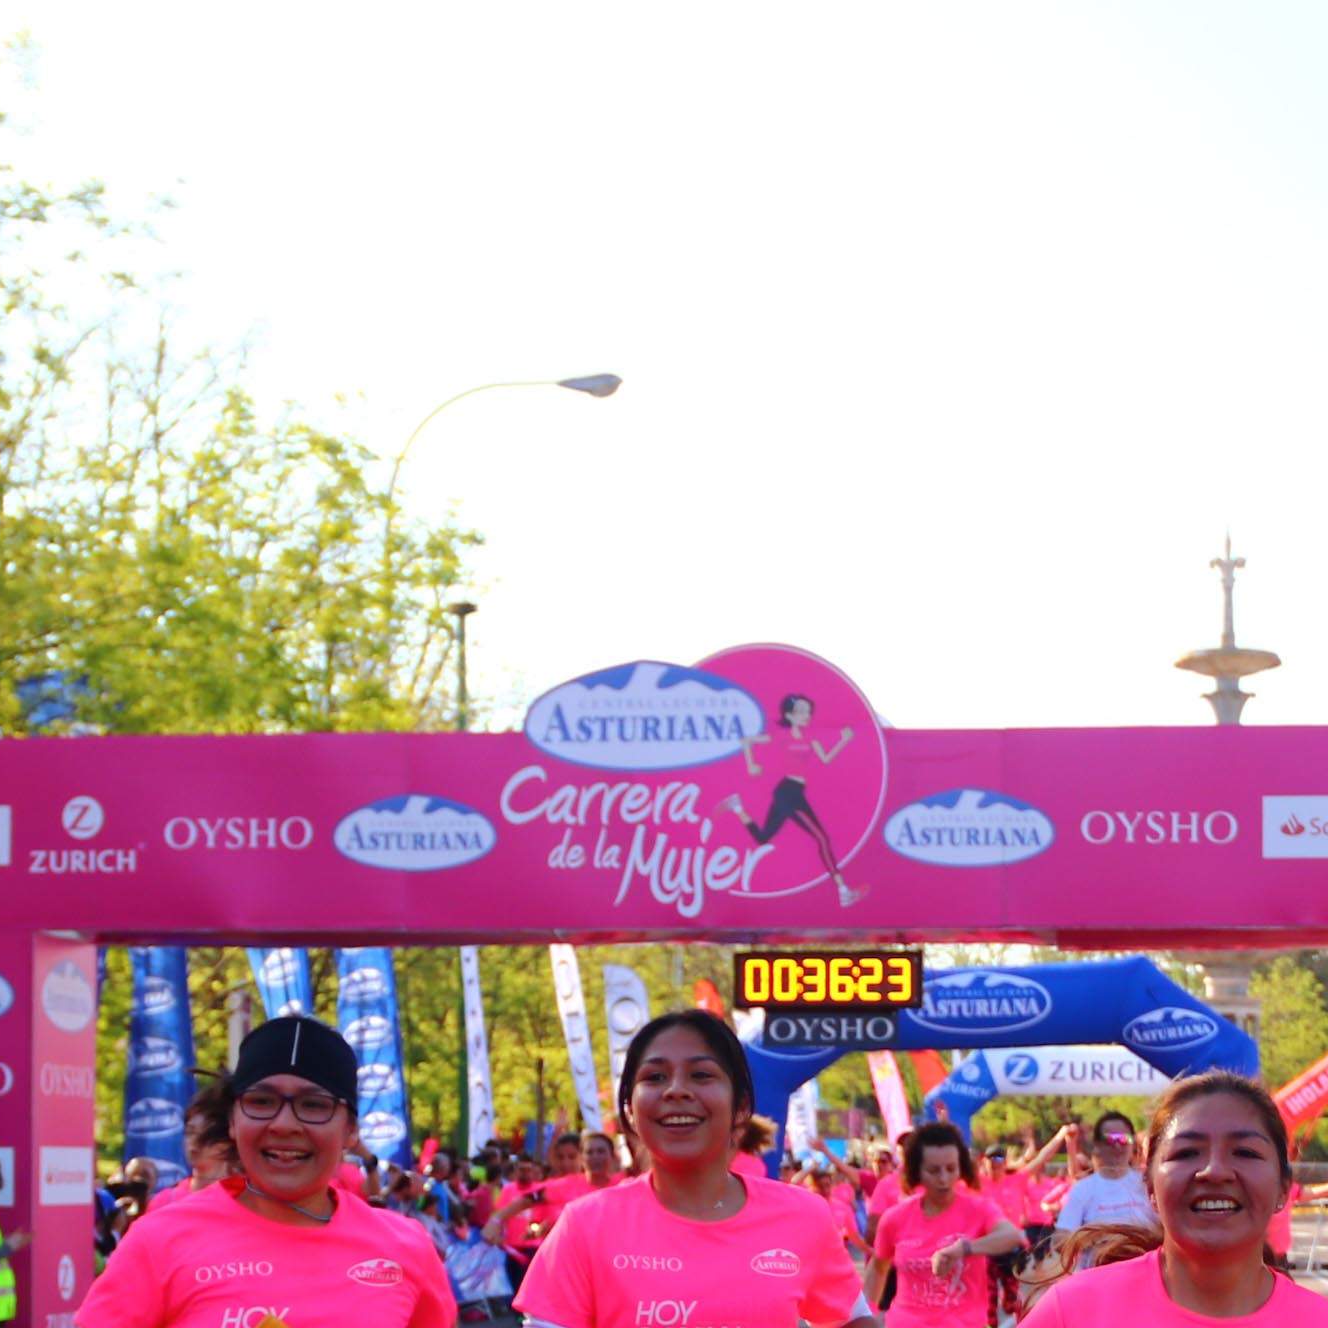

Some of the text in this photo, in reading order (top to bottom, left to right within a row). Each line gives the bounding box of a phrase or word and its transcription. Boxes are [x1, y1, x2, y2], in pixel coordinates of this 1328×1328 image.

[543, 703, 746, 744] ASTURIANA
[500, 765, 702, 826] Carrera
[164, 816, 313, 850] OYSHO
[345, 822, 483, 851] ASTURIANA
[896, 817, 1042, 848] ASTURIANA
[1080, 810, 1238, 845] OYSHO
[29, 849, 136, 874] ZURICH
[548, 818, 774, 918] de la Mujer
[744, 958, 912, 1002] 00:36:23
[917, 992, 1041, 1018] ASTURIANA
[769, 1016, 894, 1041] OYSHO
[1129, 1022, 1213, 1044] ASTURIANA
[1049, 1060, 1154, 1082] ZURICH
[195, 1261, 273, 1283] OYSHO
[613, 1254, 683, 1273] OYSHO
[635, 1300, 698, 1326] HOY
